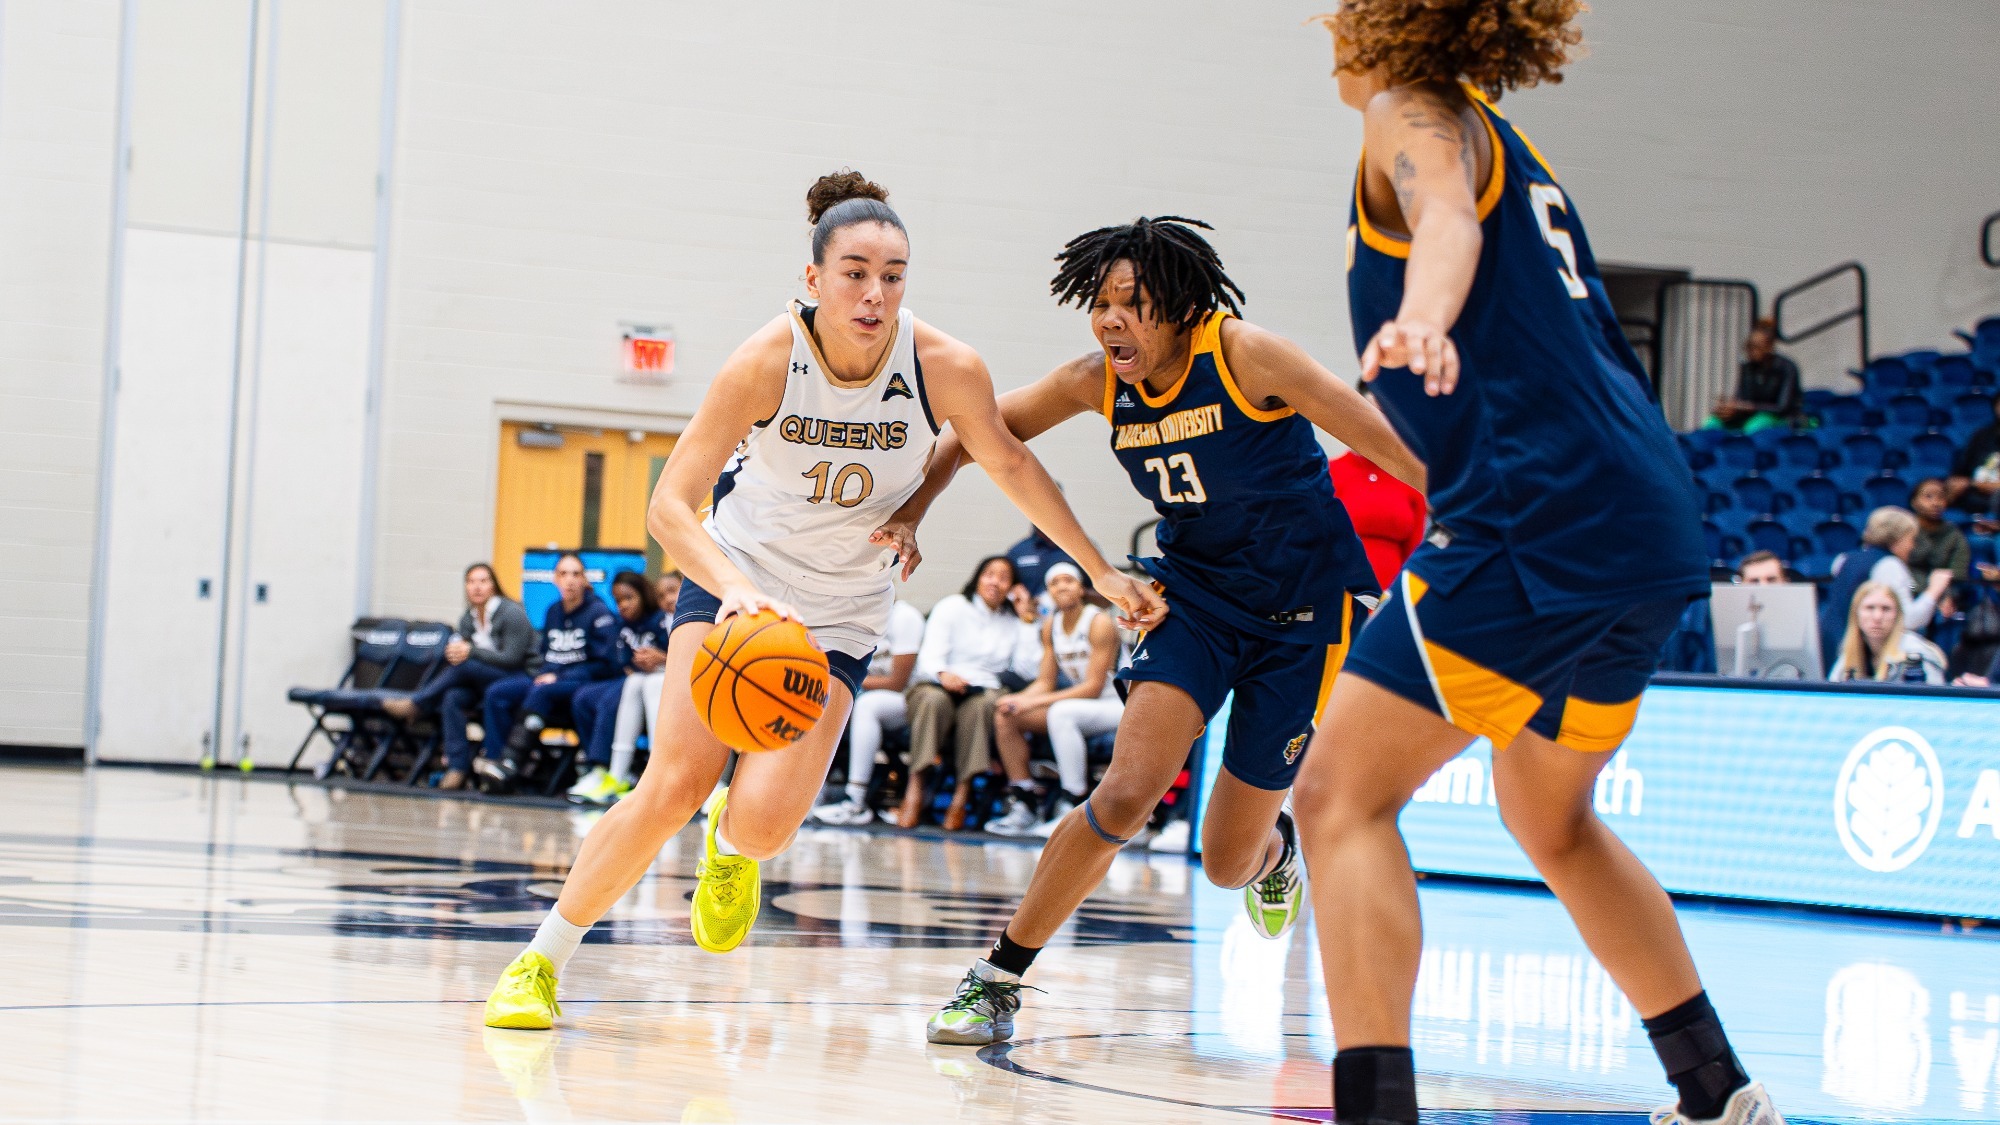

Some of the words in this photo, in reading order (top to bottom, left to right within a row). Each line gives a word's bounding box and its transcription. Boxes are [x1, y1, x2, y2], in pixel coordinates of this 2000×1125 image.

[1528, 182, 1589, 299] 5
[780, 414, 909, 451] QUEENS
[1159, 403, 1223, 443] UNIVERSITY
[802, 461, 874, 508] 10
[1144, 452, 1207, 503] 23
